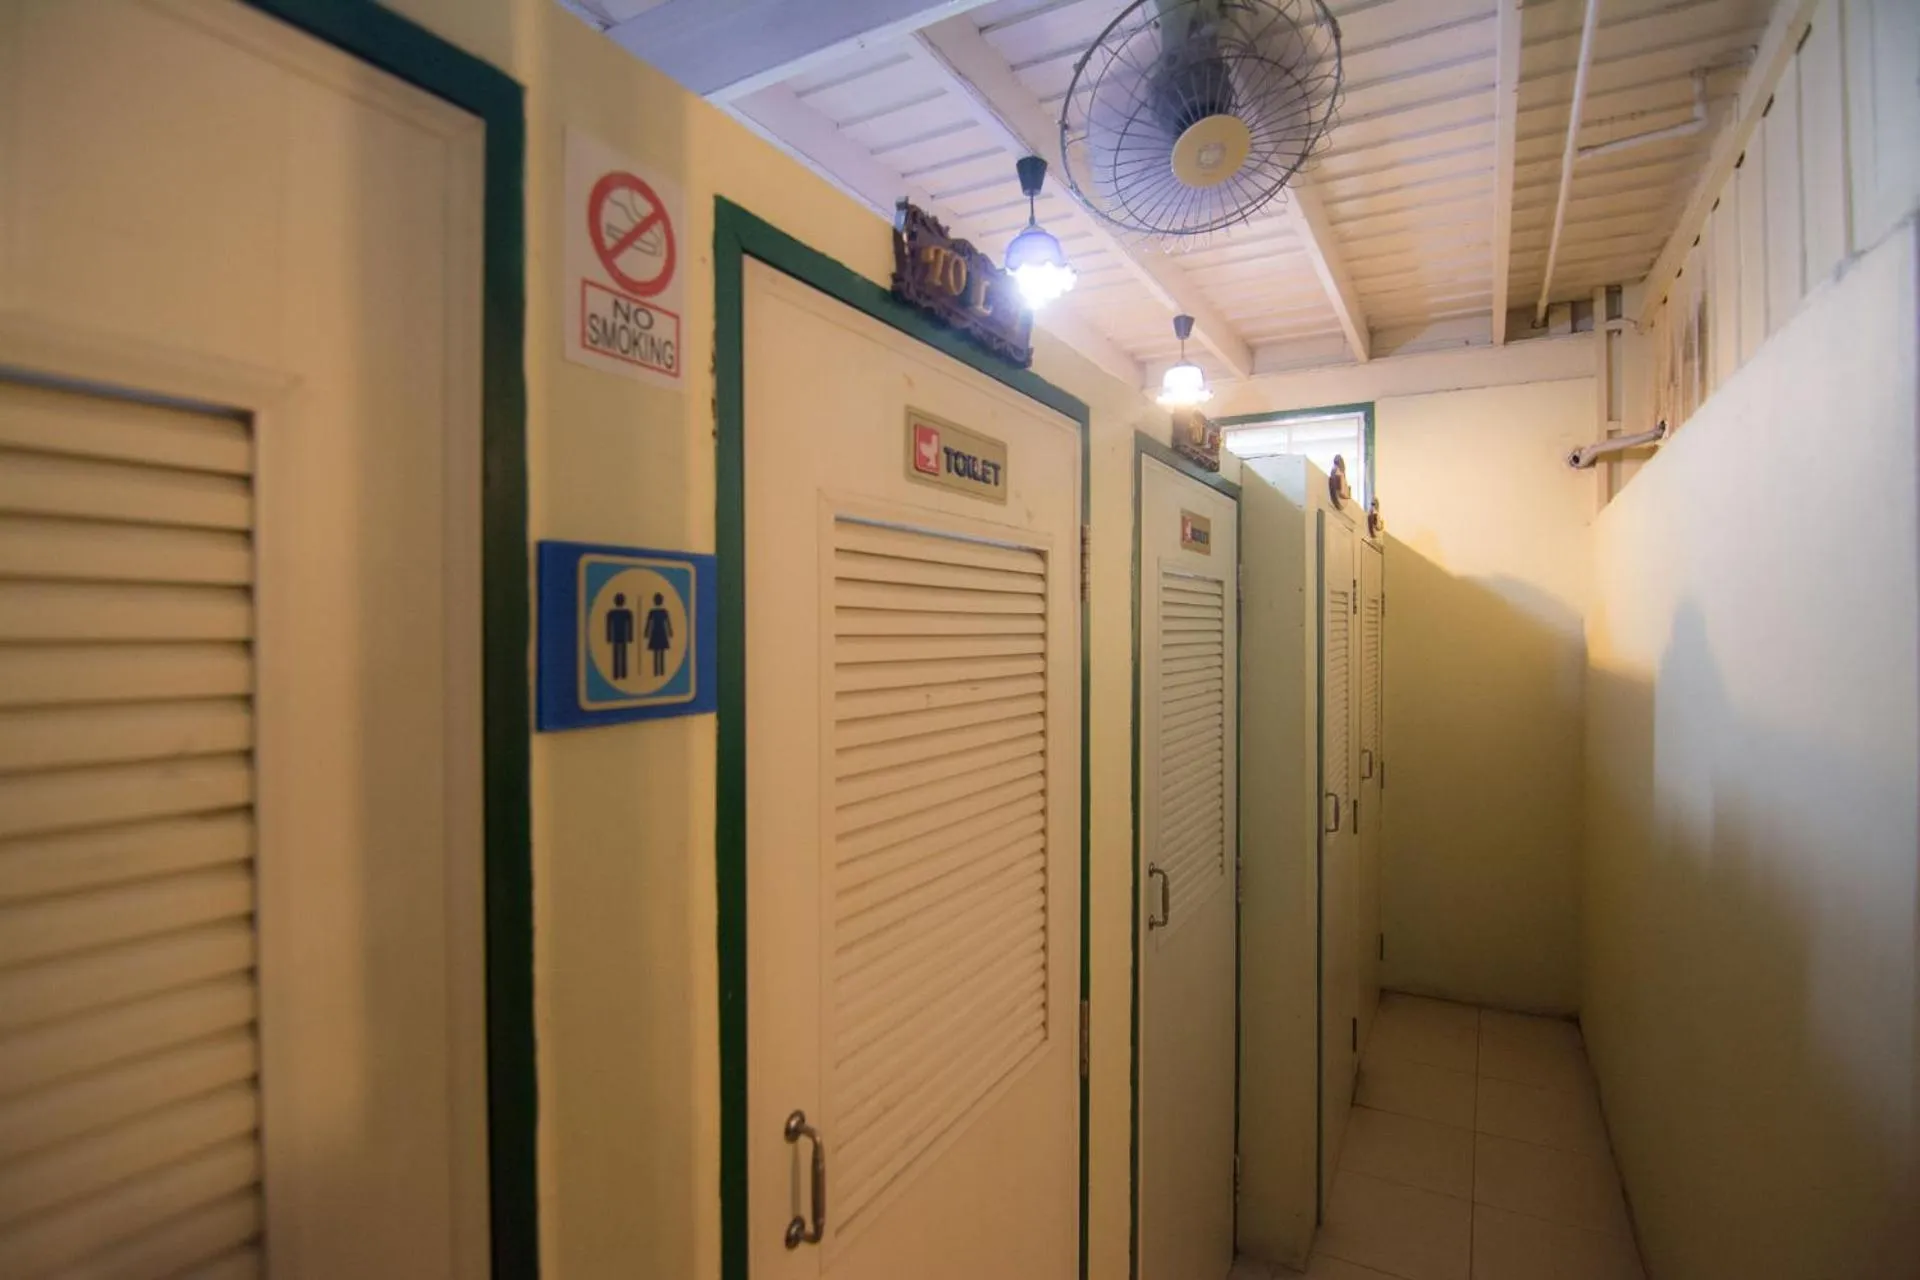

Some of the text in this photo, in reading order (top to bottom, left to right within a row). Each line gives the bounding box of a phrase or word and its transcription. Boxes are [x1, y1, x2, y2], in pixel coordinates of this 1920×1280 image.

[613, 298, 655, 330] NO
[588, 312, 675, 370] SMOKING
[943, 446, 1002, 487] TOILET
